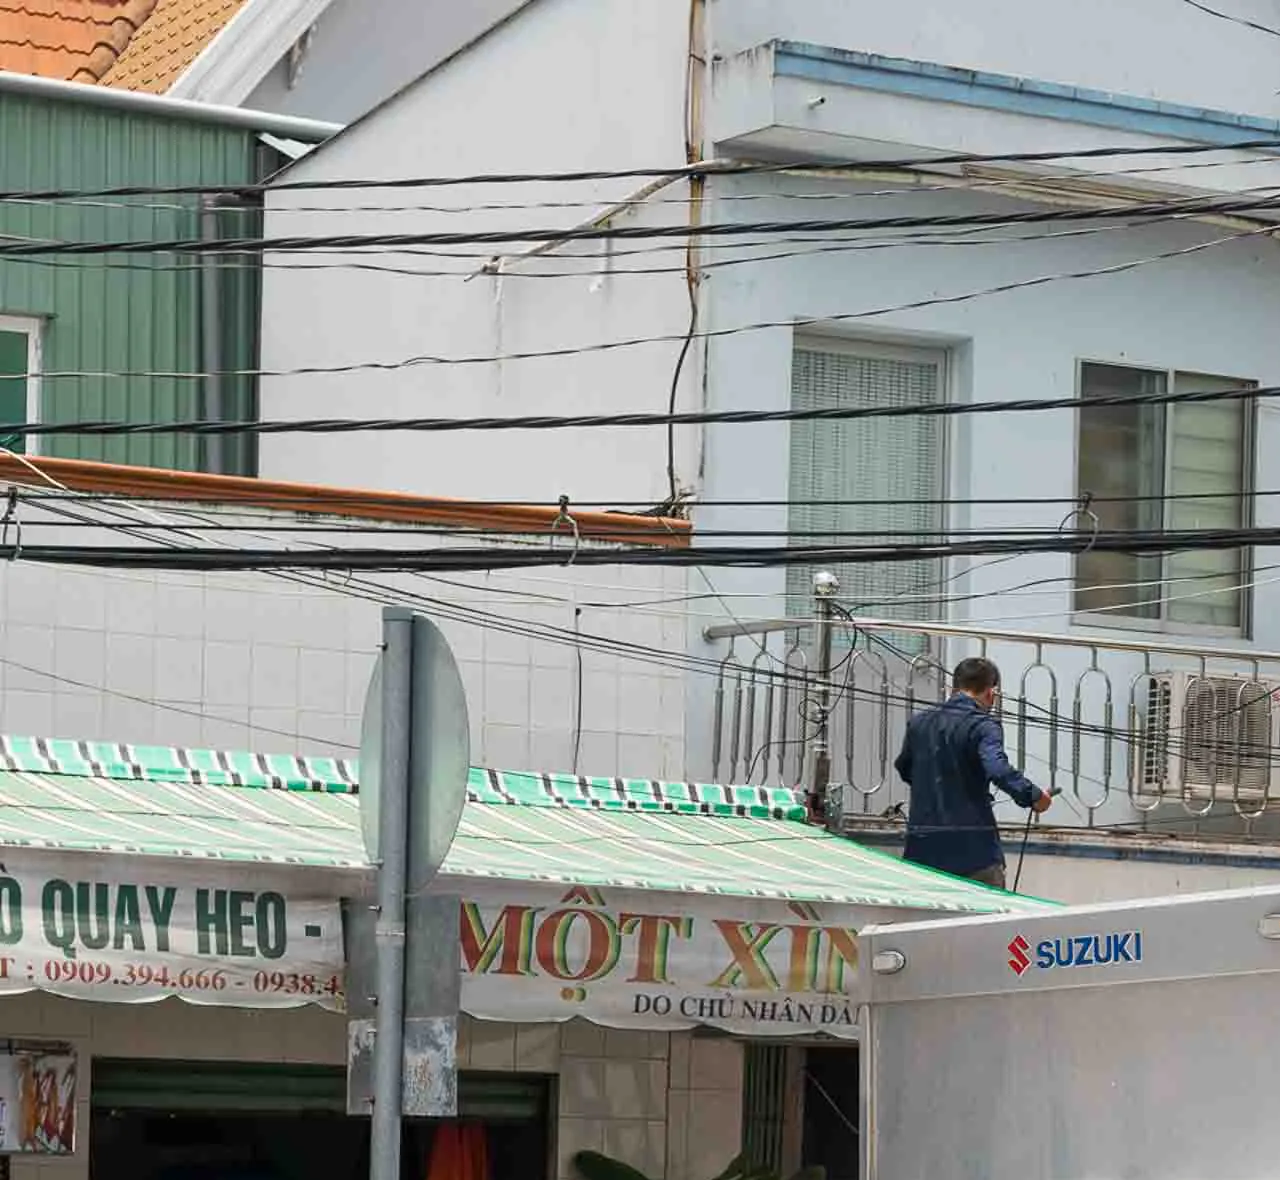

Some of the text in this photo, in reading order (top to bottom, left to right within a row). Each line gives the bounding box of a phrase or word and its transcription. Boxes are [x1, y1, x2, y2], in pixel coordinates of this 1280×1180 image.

[41, 878, 177, 959] QUAY
[195, 888, 288, 960] HEO
[460, 885, 694, 1002] MỘT
[1036, 931, 1142, 969] SUZUKI
[45, 959, 227, 991] 0909.394.666
[253, 969, 343, 996] 0938.4
[632, 993, 671, 1015] DO
[679, 991, 733, 1019] CHỦ
[741, 996, 813, 1023] NHÂN
